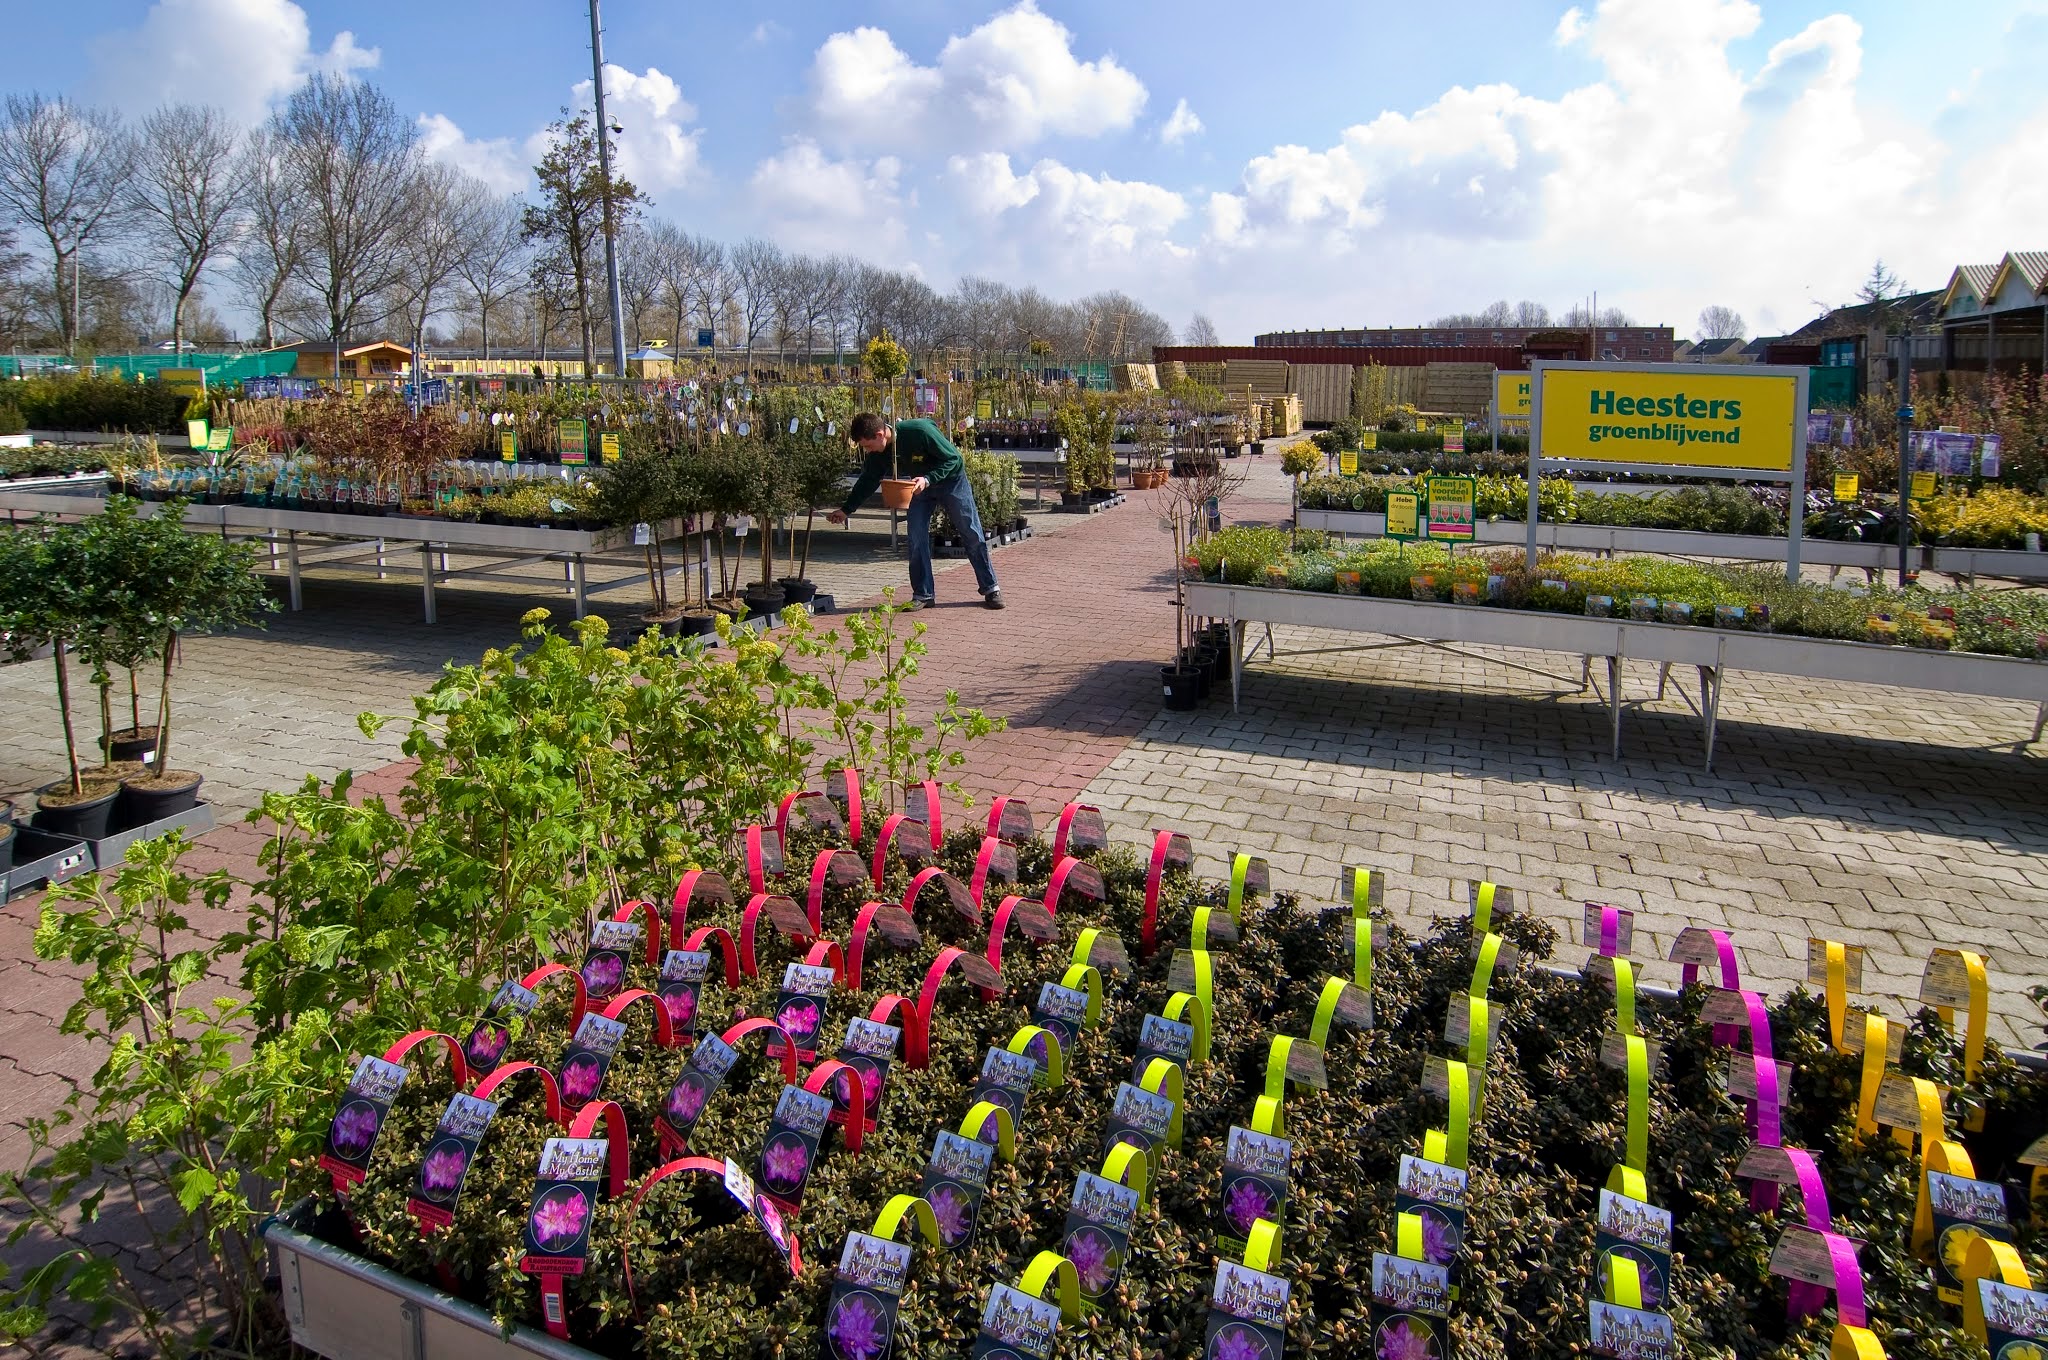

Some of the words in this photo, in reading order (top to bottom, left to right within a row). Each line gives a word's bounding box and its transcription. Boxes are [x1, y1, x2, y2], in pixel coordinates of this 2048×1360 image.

[1590, 390, 1741, 420] Heesters
[1589, 423, 1740, 446] groenblijvend
[1432, 488, 1469, 496] voordeel
[1434, 480, 1456, 488] Plant
[1459, 481, 1467, 489] je
[1435, 495, 1466, 503] weken!
[790, 980, 802, 991] My
[804, 982, 827, 993] Castle
[792, 972, 804, 983] My
[805, 974, 827, 985] Home
[580, 1033, 591, 1046] My
[593, 1037, 613, 1052] Castle
[584, 1023, 596, 1037] My
[596, 1027, 616, 1042] Home
[854, 1028, 867, 1041] My
[868, 1032, 891, 1045] Home
[851, 1037, 864, 1051] My
[866, 1041, 890, 1055] Castle
[350, 1078, 357, 1086] is
[356, 1078, 369, 1093] My
[370, 1083, 392, 1100] Castle
[362, 1068, 375, 1083] My
[374, 1072, 396, 1089] Home
[452, 1105, 464, 1121] My
[464, 1109, 485, 1125] Home
[786, 1097, 798, 1114] My
[799, 1103, 822, 1121] Home
[1113, 1106, 1120, 1115] is
[1121, 1106, 1135, 1123] My
[1137, 1114, 1165, 1133] Castle
[1123, 1095, 1138, 1113] My
[1139, 1102, 1165, 1121] Home
[440, 1117, 447, 1125] is
[446, 1116, 459, 1132] My
[460, 1121, 481, 1136] Castle
[775, 1108, 782, 1117] is
[782, 1108, 795, 1125] My
[796, 1115, 820, 1133] Castle
[551, 1151, 567, 1165] My
[569, 1151, 599, 1163] Home
[942, 1144, 956, 1162] My
[957, 1150, 983, 1169] Home
[1227, 1152, 1234, 1162] is
[1236, 1152, 1251, 1169] My
[1254, 1157, 1285, 1175] Castle
[1237, 1140, 1252, 1157] My
[1255, 1145, 1284, 1163] Home
[540, 1165, 547, 1173] is
[548, 1163, 565, 1177] My
[567, 1163, 598, 1175] Castle
[931, 1157, 938, 1166] is
[939, 1156, 953, 1174] My
[955, 1163, 983, 1182] Castle
[1410, 1168, 1426, 1185] My
[1429, 1174, 1460, 1192] Home
[1083, 1186, 1098, 1205] My
[1100, 1193, 1129, 1214] Home
[1400, 1180, 1407, 1189] is
[1409, 1180, 1425, 1197] My
[1428, 1186, 1462, 1204] Castle
[1941, 1185, 1961, 1203] My
[1963, 1191, 2000, 1209] Home
[1072, 1199, 1079, 1209] is
[1080, 1199, 1096, 1218] My
[1098, 1206, 1128, 1227] Castle
[1611, 1204, 1628, 1224] My
[1632, 1212, 1665, 1235] Home
[1932, 1198, 1941, 1208] is
[1943, 1198, 1963, 1216] My
[1966, 1204, 2005, 1222] Castle
[1600, 1216, 1608, 1227] is
[1610, 1217, 1628, 1237] My
[1631, 1226, 1668, 1248] Castle
[852, 1248, 869, 1267] My
[870, 1253, 901, 1273] Home
[840, 1263, 848, 1273] is
[848, 1262, 865, 1281] My
[868, 1267, 900, 1288] Castle
[1384, 1270, 1402, 1290] My
[1406, 1275, 1441, 1295] Home
[1226, 1278, 1244, 1299] My
[1247, 1285, 1281, 1307] Home
[1374, 1285, 1382, 1296] is
[1385, 1284, 1403, 1305] My
[1406, 1290, 1444, 1311] Castle
[997, 1301, 1015, 1324] My
[1016, 1310, 1048, 1336] Home
[1215, 1292, 1223, 1303] is
[1224, 1292, 1242, 1313] My
[1246, 1300, 1282, 1322] Castle
[1994, 1296, 2017, 1317] My
[1603, 1319, 1624, 1340] My
[1627, 1324, 1667, 1346] Home
[1985, 1311, 1996, 1323] is
[1997, 1310, 2021, 1331] My
[984, 1315, 992, 1328] is
[993, 1316, 1010, 1339] My
[1013, 1326, 1047, 1352] Castle
[1593, 1335, 1602, 1347] is
[1604, 1334, 1626, 1356] My
